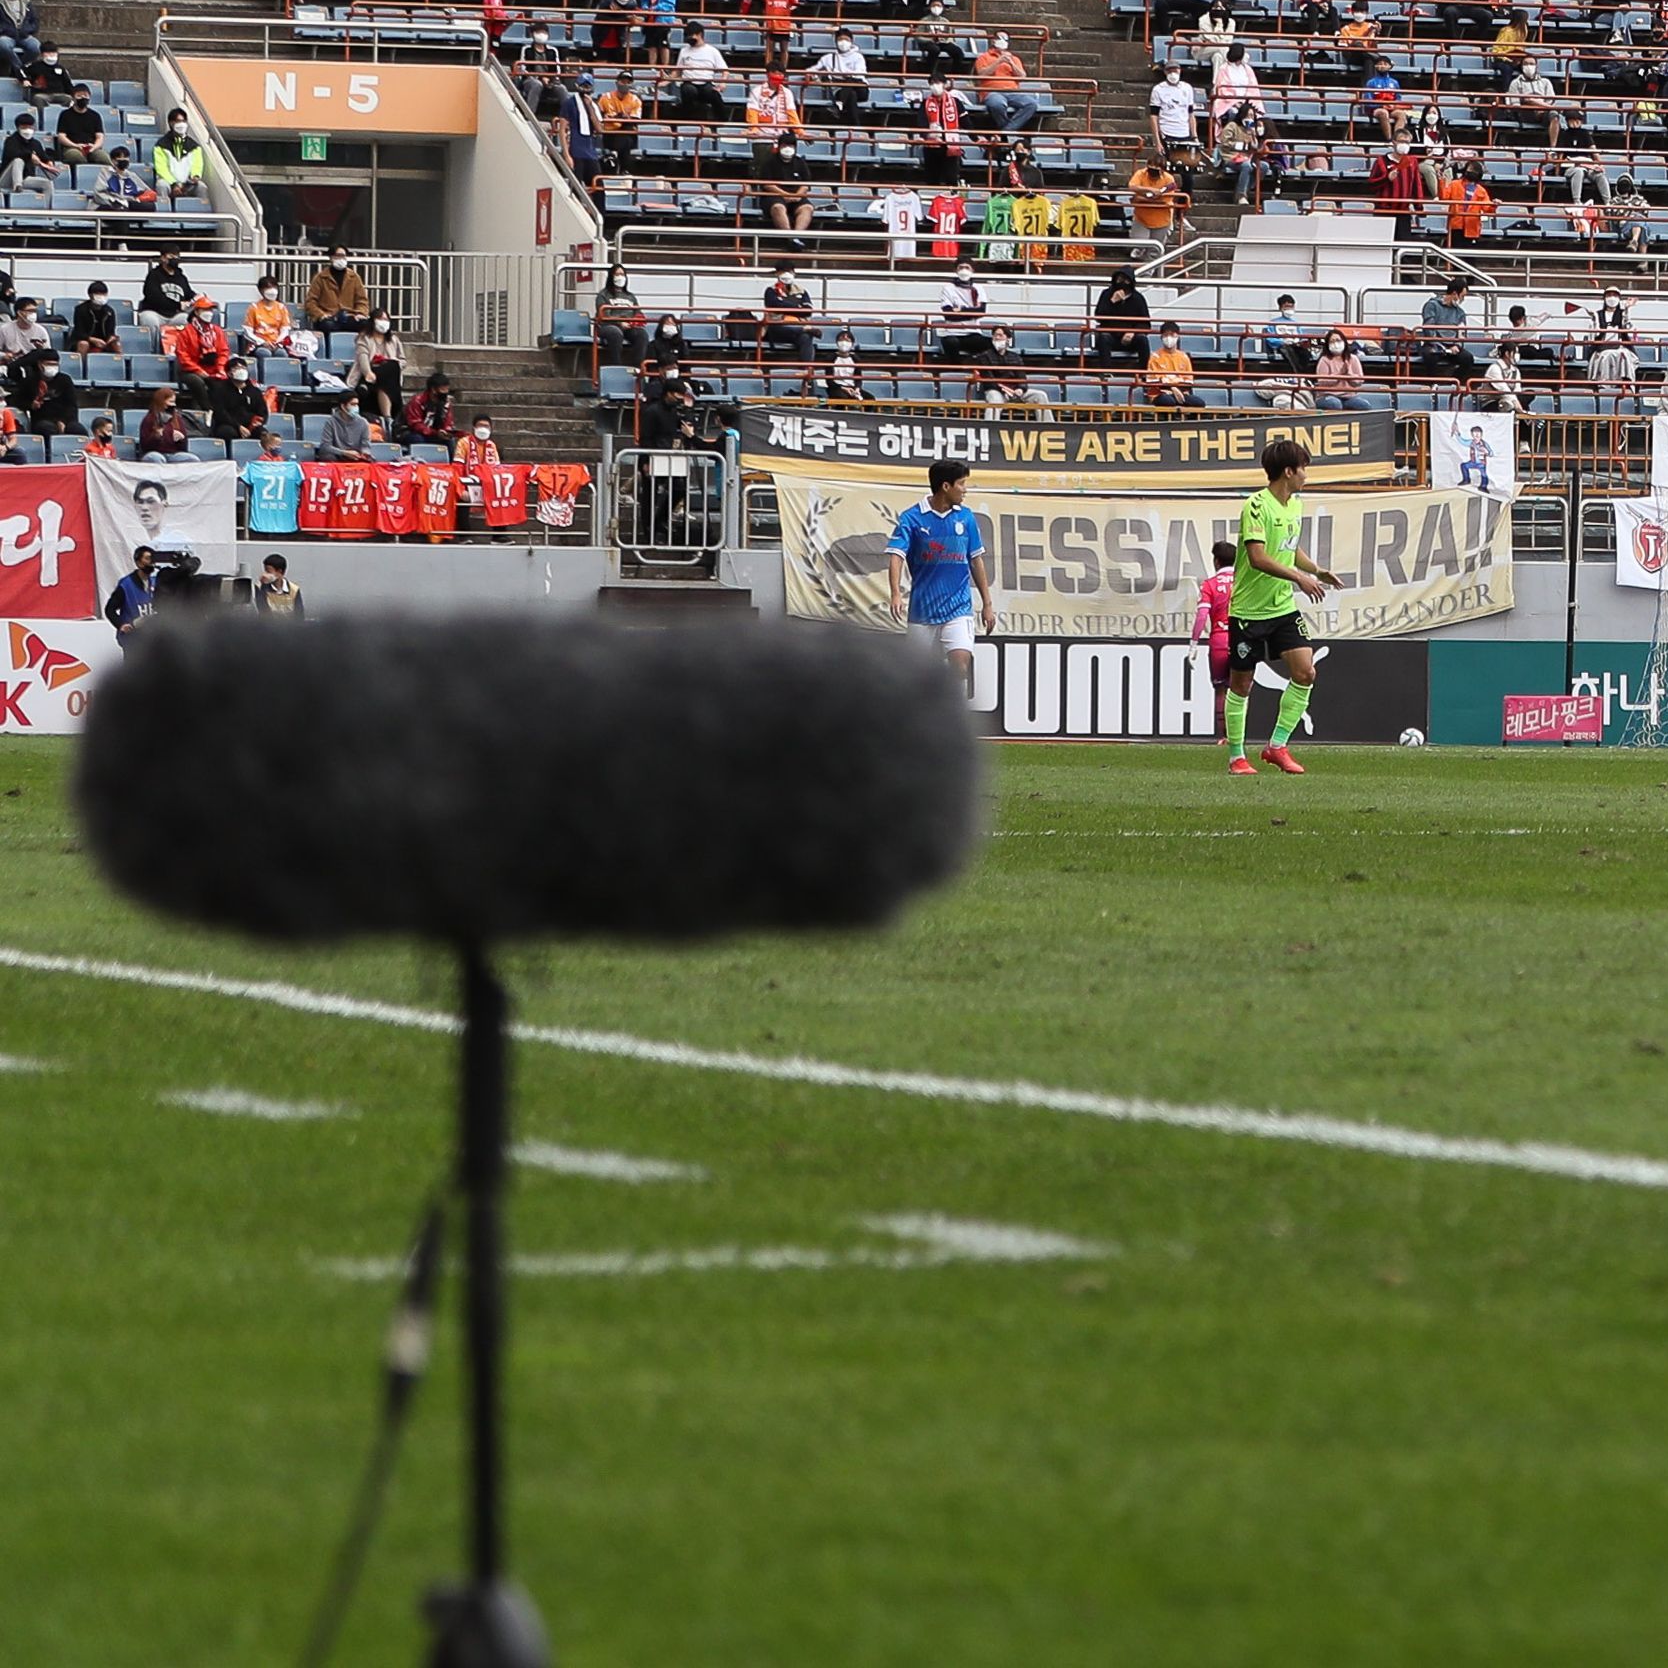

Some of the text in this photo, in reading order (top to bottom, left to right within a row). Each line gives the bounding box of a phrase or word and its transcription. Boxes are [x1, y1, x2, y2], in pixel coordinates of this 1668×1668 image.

[767, 415, 1361, 463] 제주는 하나다! WE ARE THE ONE!
[262, 475, 285, 500] 21
[309, 477, 332, 503] 13
[345, 477, 365, 504] 22
[386, 477, 401, 502] 5
[428, 478, 449, 506] 35
[493, 473, 515, 498] 17
[1351, 582, 1496, 633] ISLANDER
[1072, 611, 1196, 637] SUPPORTE
[1506, 704, 1560, 738] 레모나
[1560, 697, 1596, 727] 핑크
